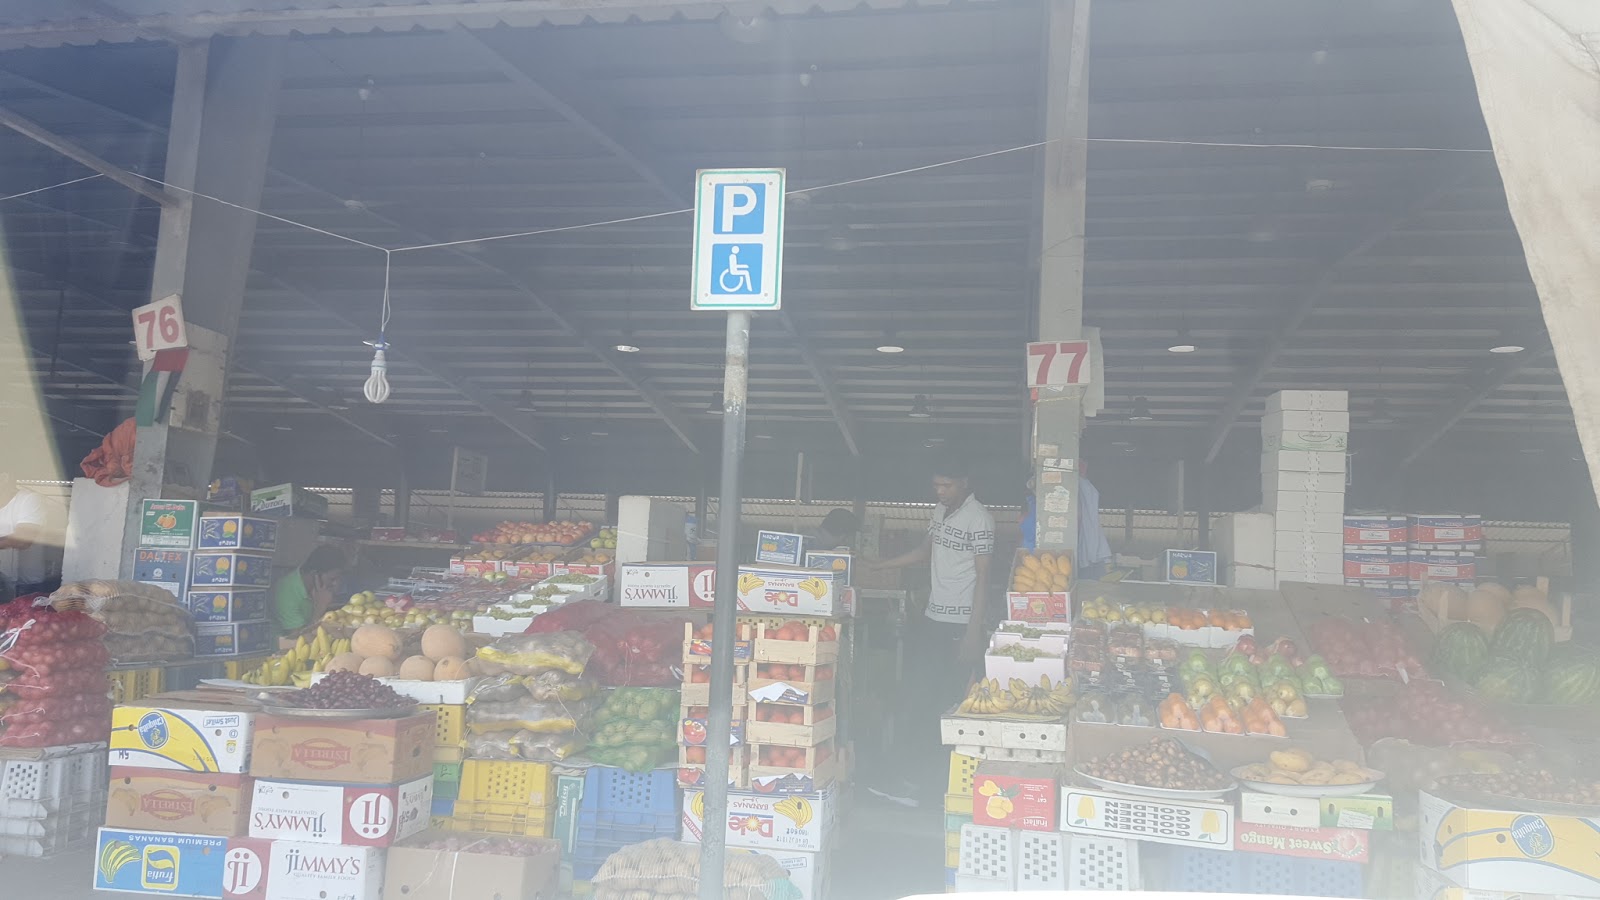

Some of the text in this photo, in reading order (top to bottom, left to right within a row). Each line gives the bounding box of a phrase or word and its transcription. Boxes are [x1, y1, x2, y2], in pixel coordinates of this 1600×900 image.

[721, 185, 757, 232] P
[138, 305, 179, 349] 76
[1029, 342, 1088, 385] 77
[139, 551, 182, 560] DALTEX
[765, 591, 798, 607] Dole
[140, 717, 165, 736] Chiquita
[294, 749, 349, 762] ESTRELLA
[143, 797, 193, 813] ESTRELLA
[733, 802, 769, 810] BANANAS
[1104, 801, 1191, 816] GOLDEN
[1104, 808, 1191, 823] GOLDEN
[1104, 814, 1191, 830] GOLDEN
[728, 815, 774, 838] Dole
[1104, 821, 1191, 837] GOLDEN
[1512, 817, 1546, 839] Chiquita
[128, 834, 222, 847] PREMIUM BANANAS
[1240, 831, 1333, 854] Sweet Mango
